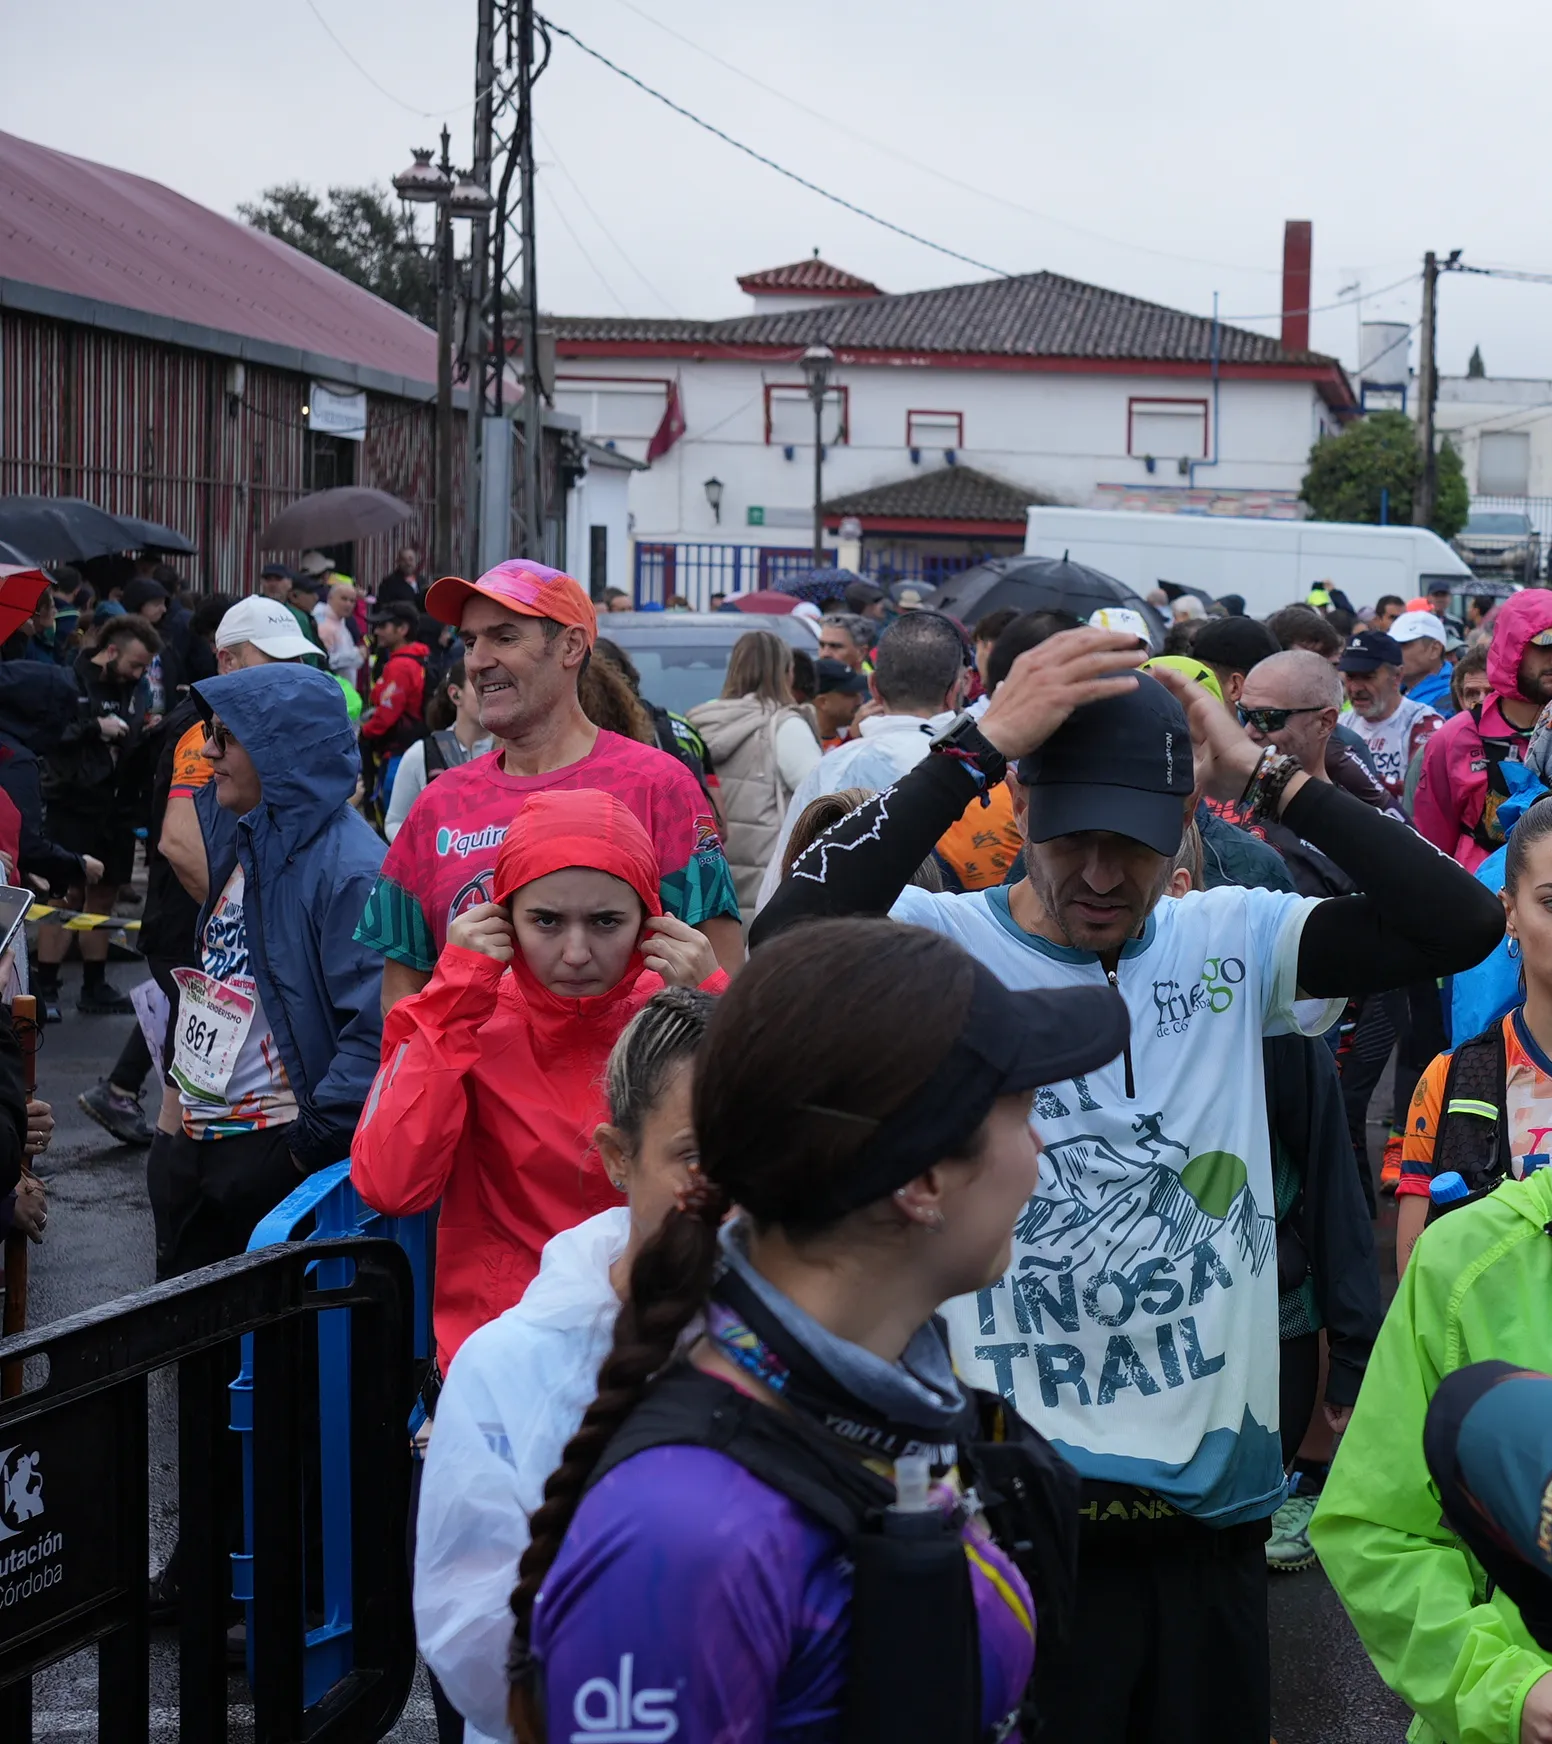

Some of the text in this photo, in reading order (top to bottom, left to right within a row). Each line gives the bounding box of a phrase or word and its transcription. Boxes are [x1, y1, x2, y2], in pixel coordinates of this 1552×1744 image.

[1165, 732, 1173, 786] SALOMON
[185, 1014, 218, 1057] 861
[206, 1001, 242, 1025] SENDERISMO
[974, 1315, 1226, 1409] TRAIL
[569, 1651, 680, 1744] als
